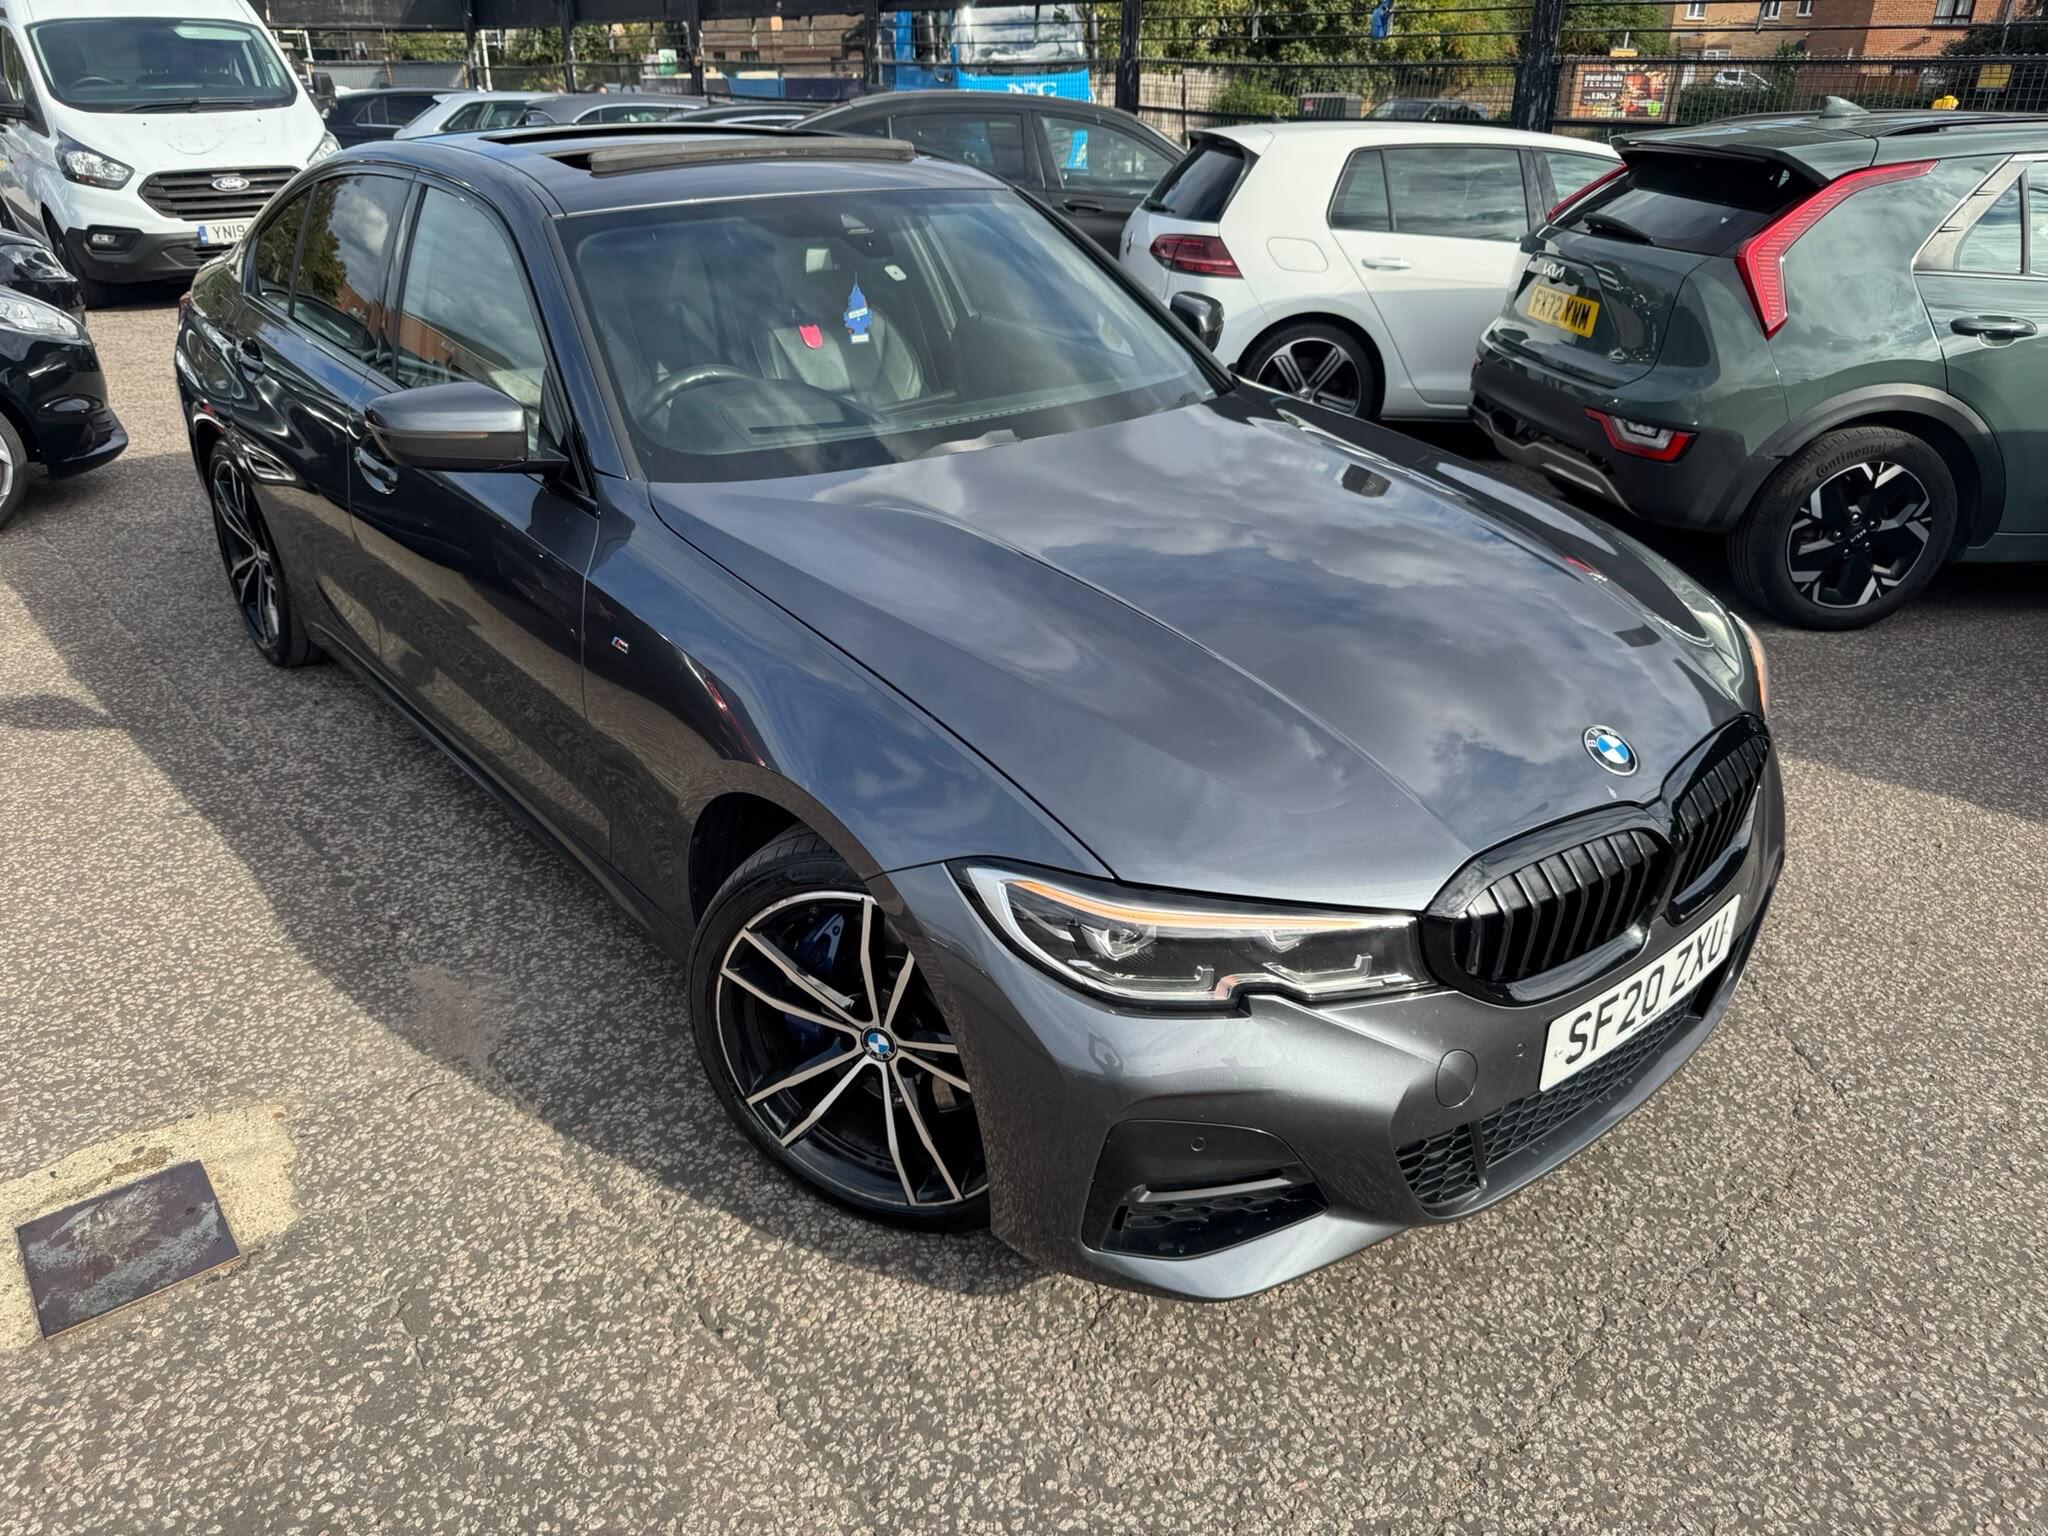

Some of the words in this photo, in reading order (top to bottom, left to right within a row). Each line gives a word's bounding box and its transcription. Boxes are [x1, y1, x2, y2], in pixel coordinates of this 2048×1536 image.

[212, 225, 245, 239] YN19
[1815, 442, 1886, 477] Continental
[1565, 965, 1665, 1065] SF20
[1670, 910, 1729, 998] ZXU
